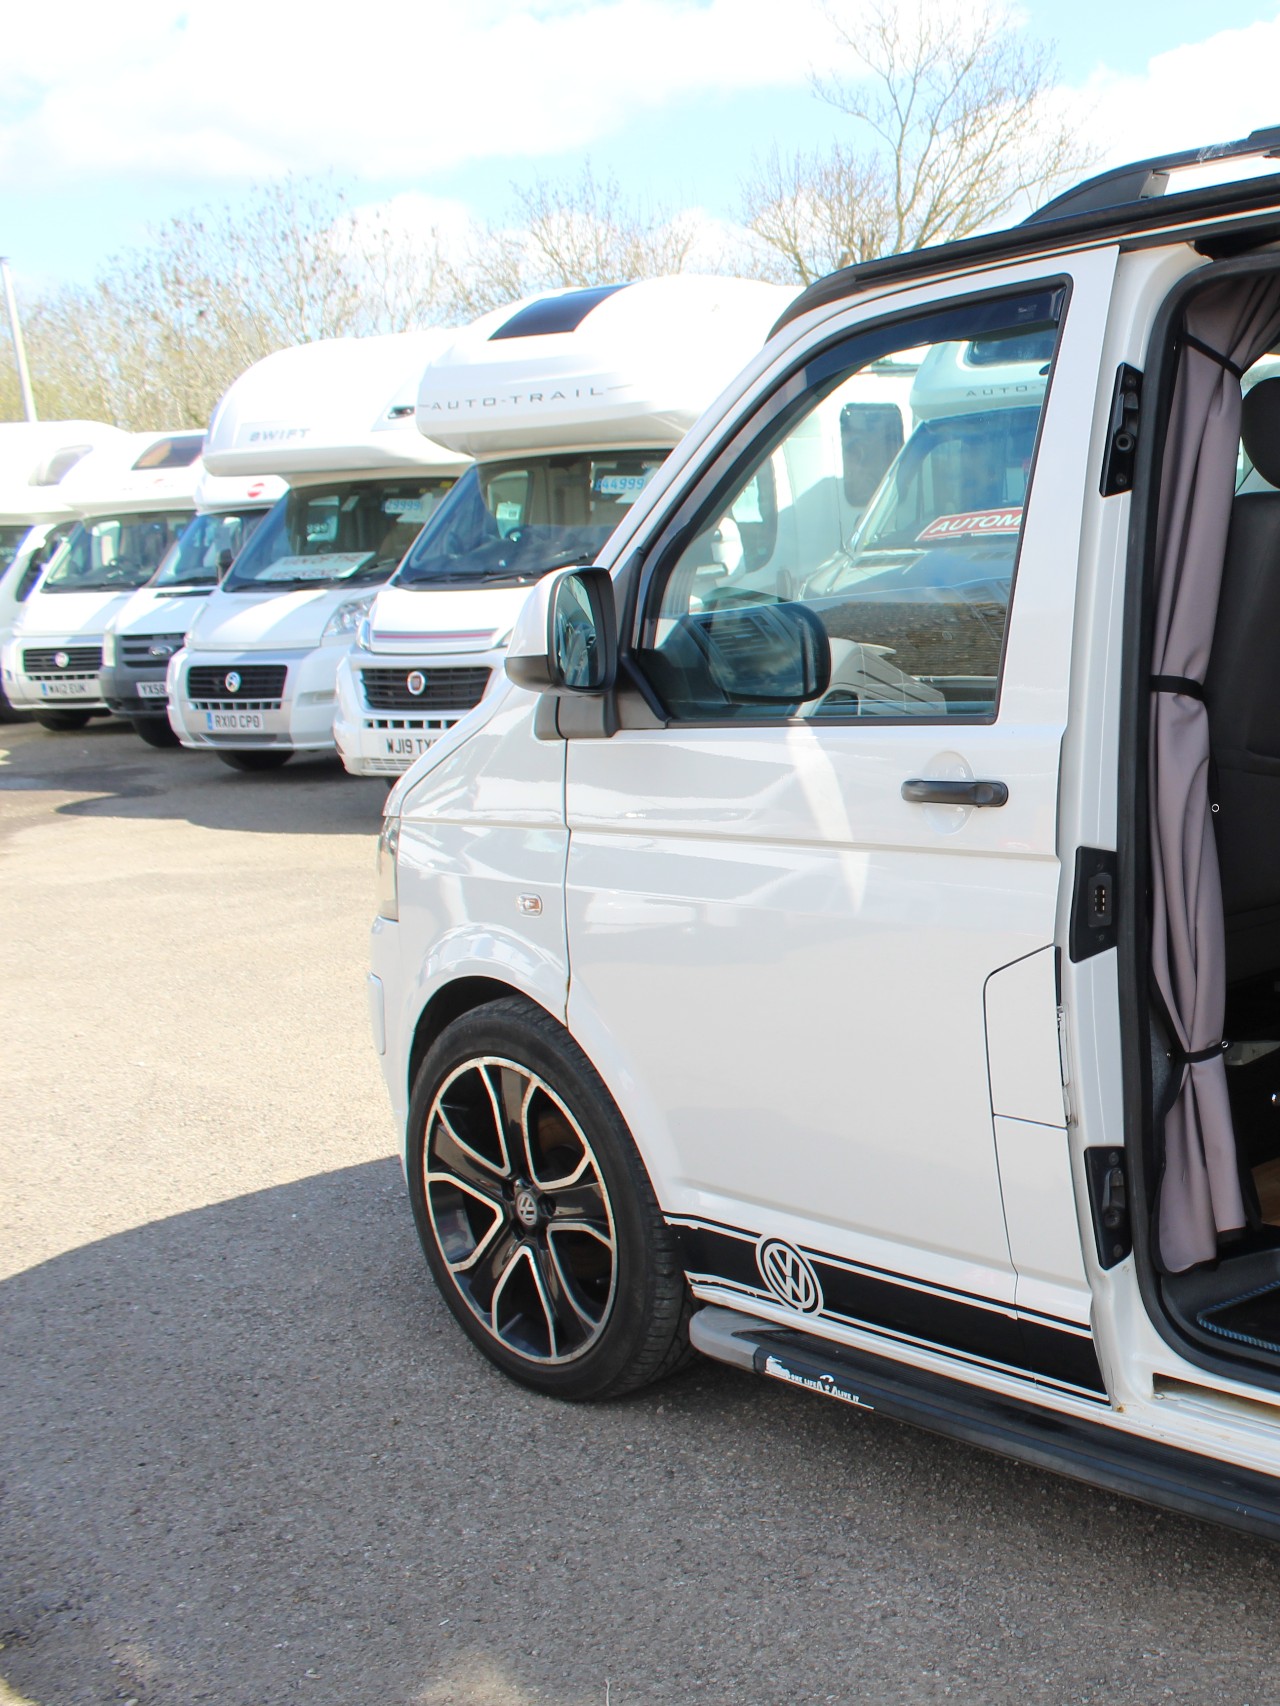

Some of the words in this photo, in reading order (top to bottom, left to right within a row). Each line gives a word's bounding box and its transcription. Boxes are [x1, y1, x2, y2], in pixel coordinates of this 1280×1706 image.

[431, 387, 603, 410] AUTO-TRAIL
[249, 428, 310, 442] SWIFT
[386, 739, 413, 754] WJ19
